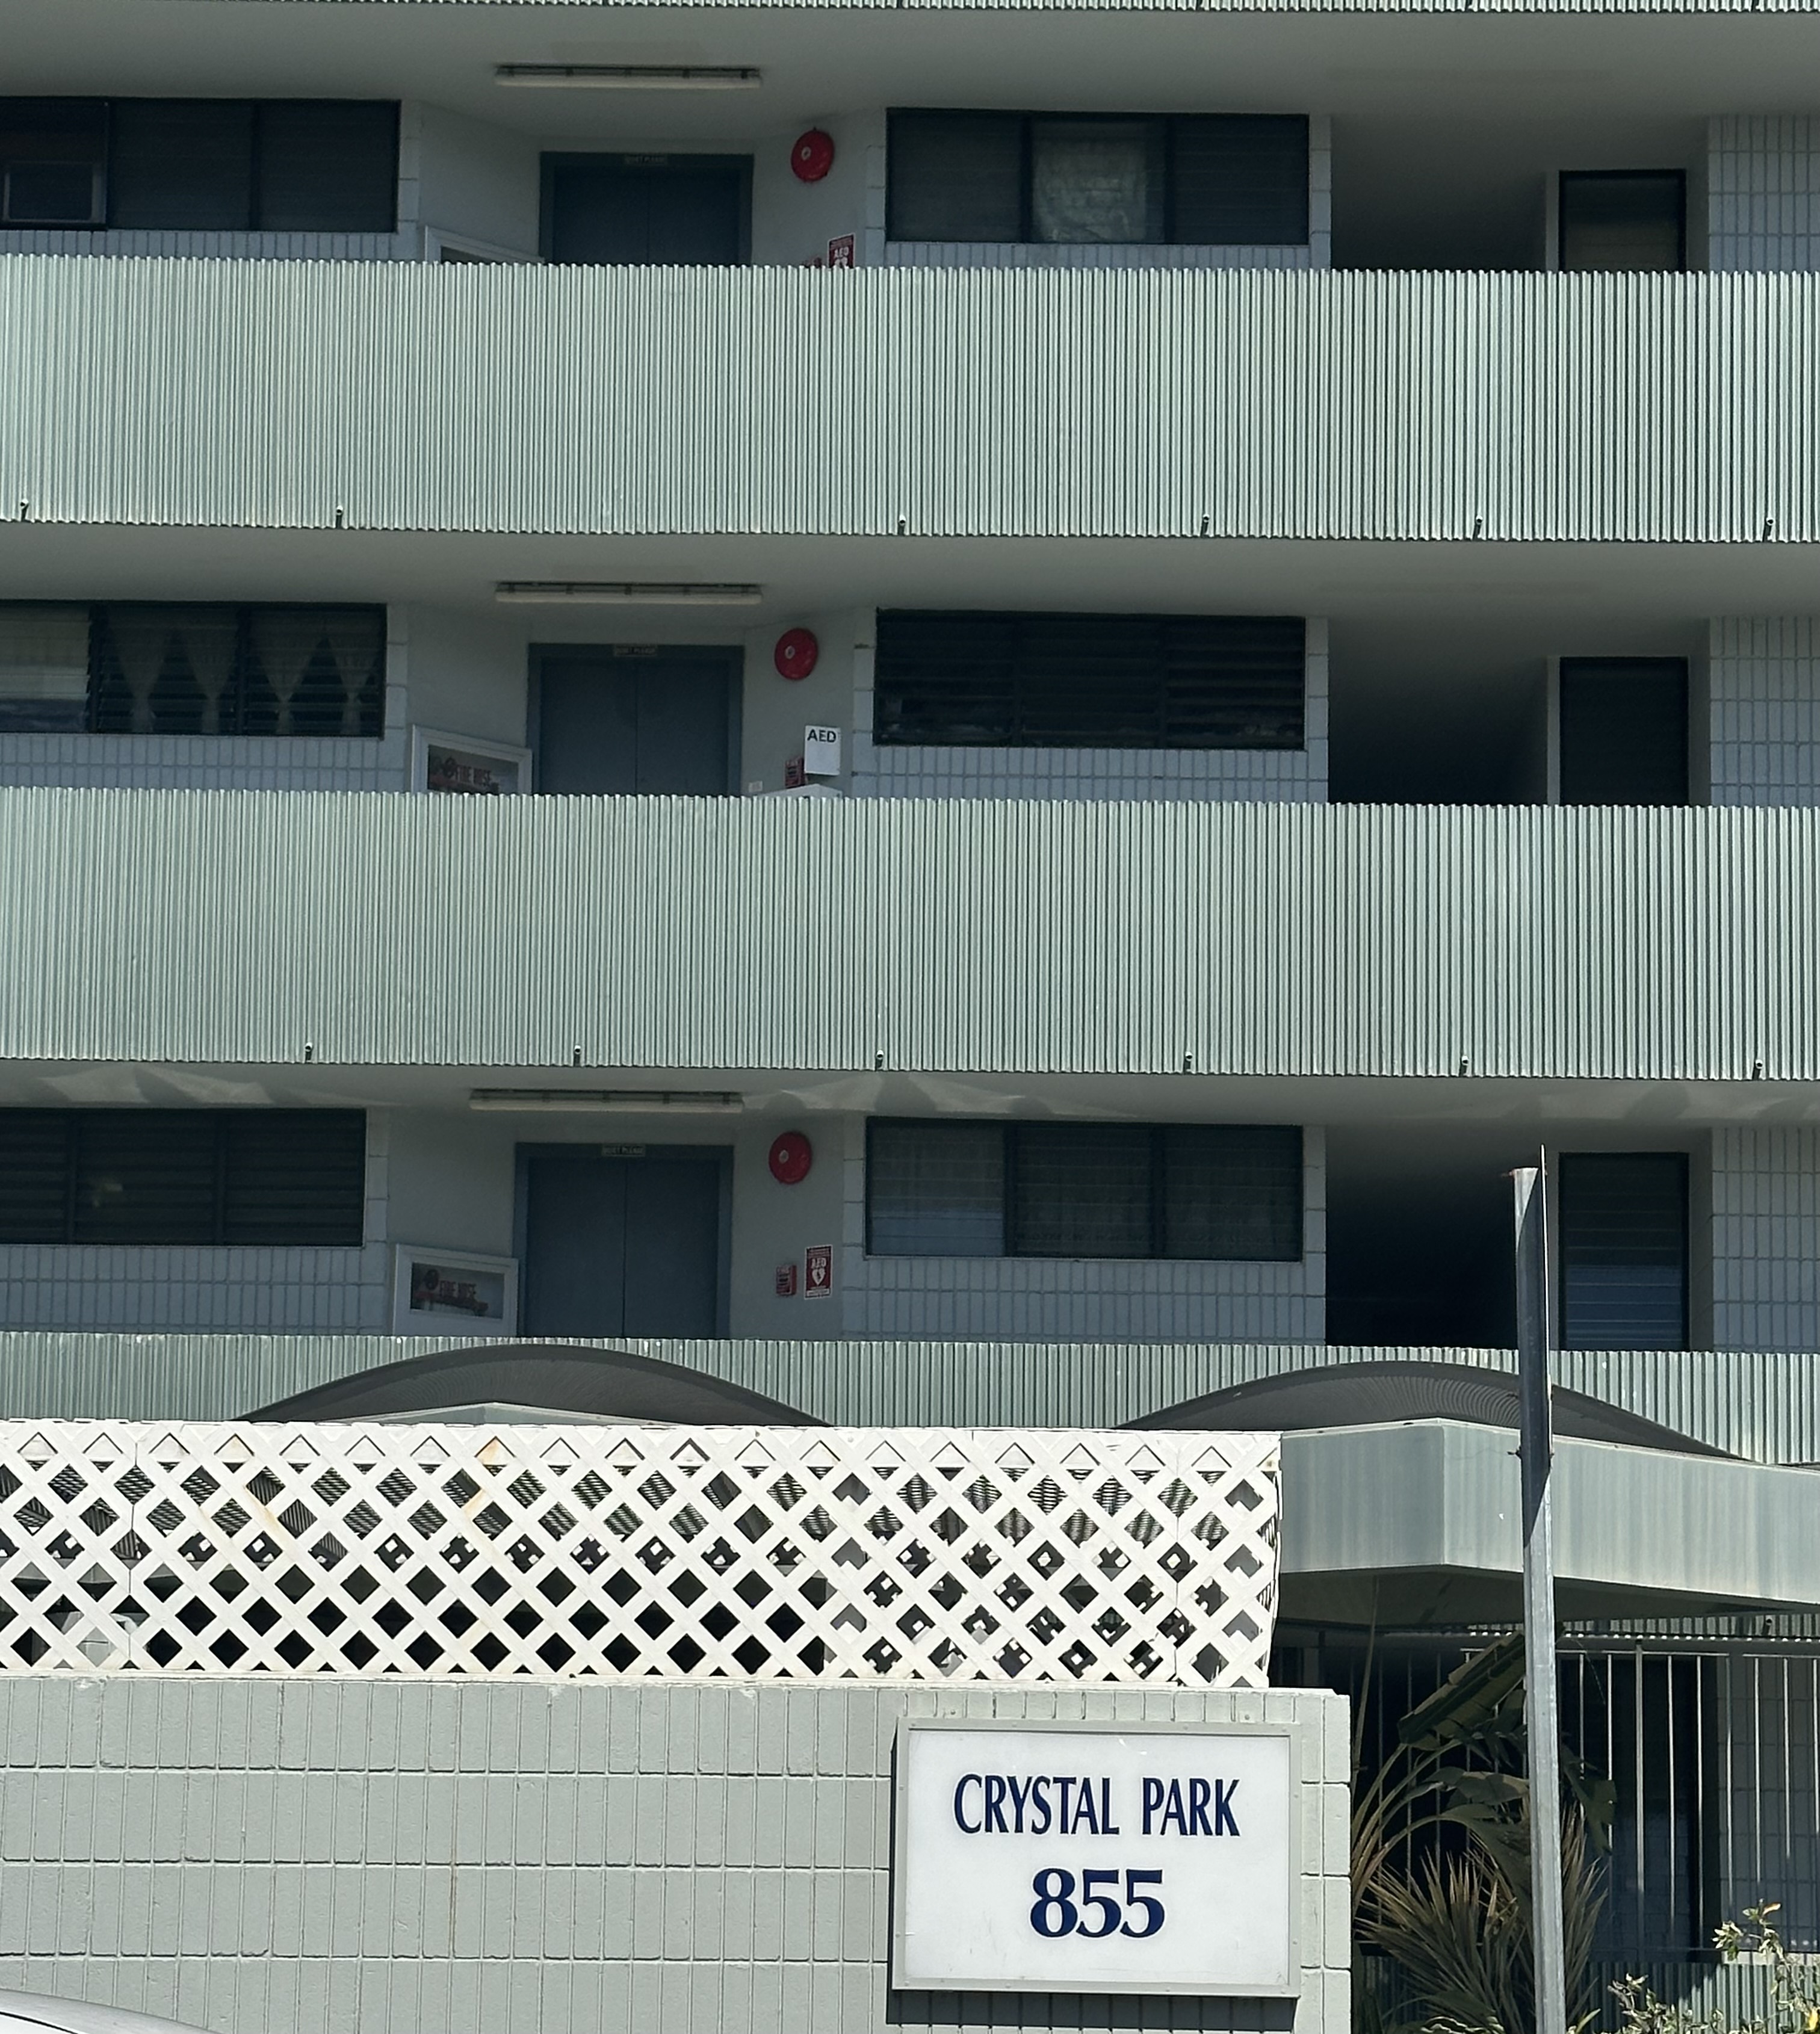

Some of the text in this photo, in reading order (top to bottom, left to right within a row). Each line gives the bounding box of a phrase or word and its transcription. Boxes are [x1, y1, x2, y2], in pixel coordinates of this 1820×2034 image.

[807, 729, 837, 743] AED
[954, 1773, 1240, 1837] CRYSTAL PARK
[1030, 1868, 1165, 1938] 855
